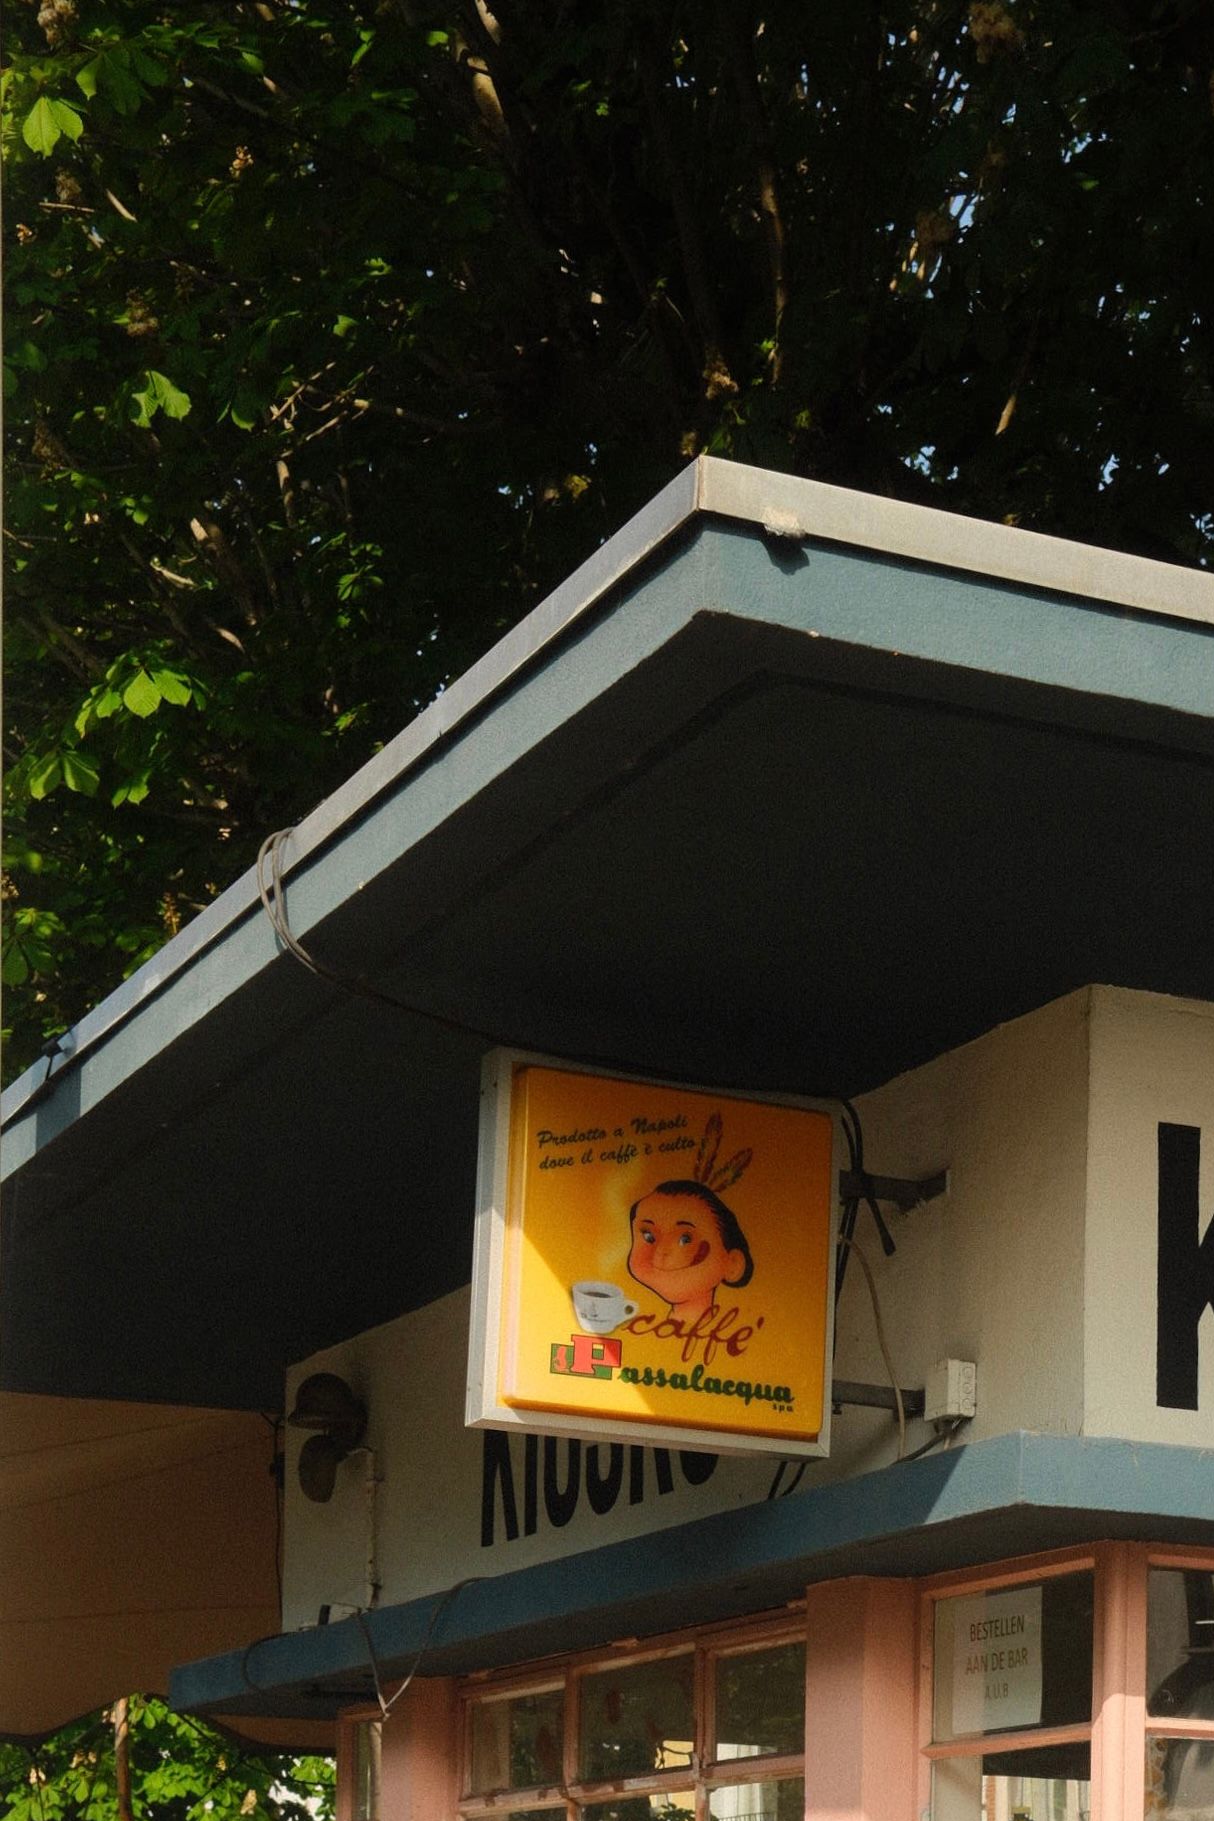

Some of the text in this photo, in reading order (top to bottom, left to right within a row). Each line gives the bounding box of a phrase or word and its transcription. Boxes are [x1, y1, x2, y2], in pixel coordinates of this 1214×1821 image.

[536, 1113, 689, 1149] Prodotto a Napoli
[538, 1155, 575, 1170] dove
[580, 1150, 594, 1165] il
[658, 1136, 696, 1153] culto
[970, 1615, 1025, 1642] BESTELLEN
[965, 1647, 1029, 1676] AAN DE BAR
